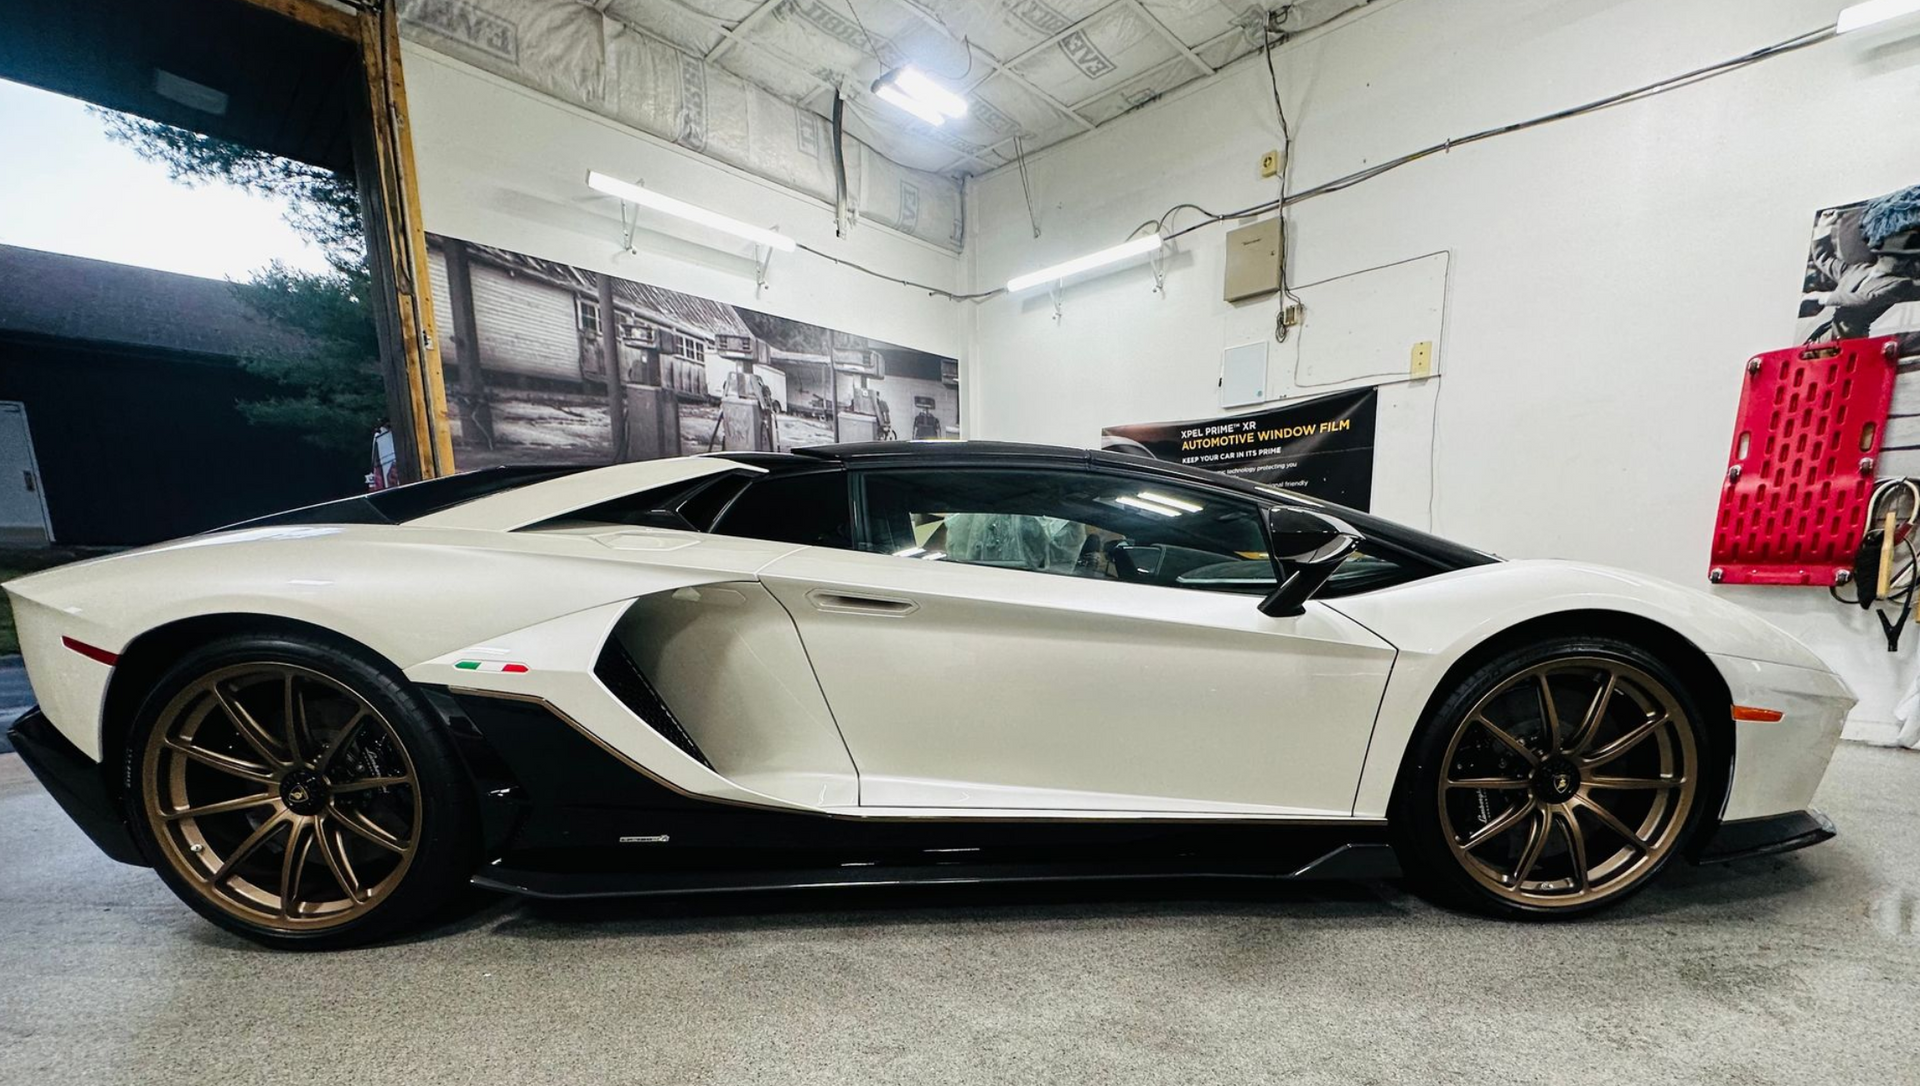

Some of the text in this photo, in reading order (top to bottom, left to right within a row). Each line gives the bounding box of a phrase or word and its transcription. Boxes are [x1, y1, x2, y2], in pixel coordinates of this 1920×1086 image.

[1181, 428, 1204, 439] XPEL
[1242, 421, 1257, 431] XR
[1182, 419, 1350, 451] AUTOMOTIVE WINDOW FILM
[1182, 456, 1200, 464] KEEP
[1200, 454, 1219, 462] YOUR
[1220, 452, 1235, 460] CAR
[1245, 449, 1257, 457] ITS
[1258, 446, 1282, 456] PRIME
[1227, 465, 1256, 475] technology
[1257, 463, 1286, 473] protecting
[1286, 462, 1298, 470] you
[1284, 479, 1309, 488] friendly
